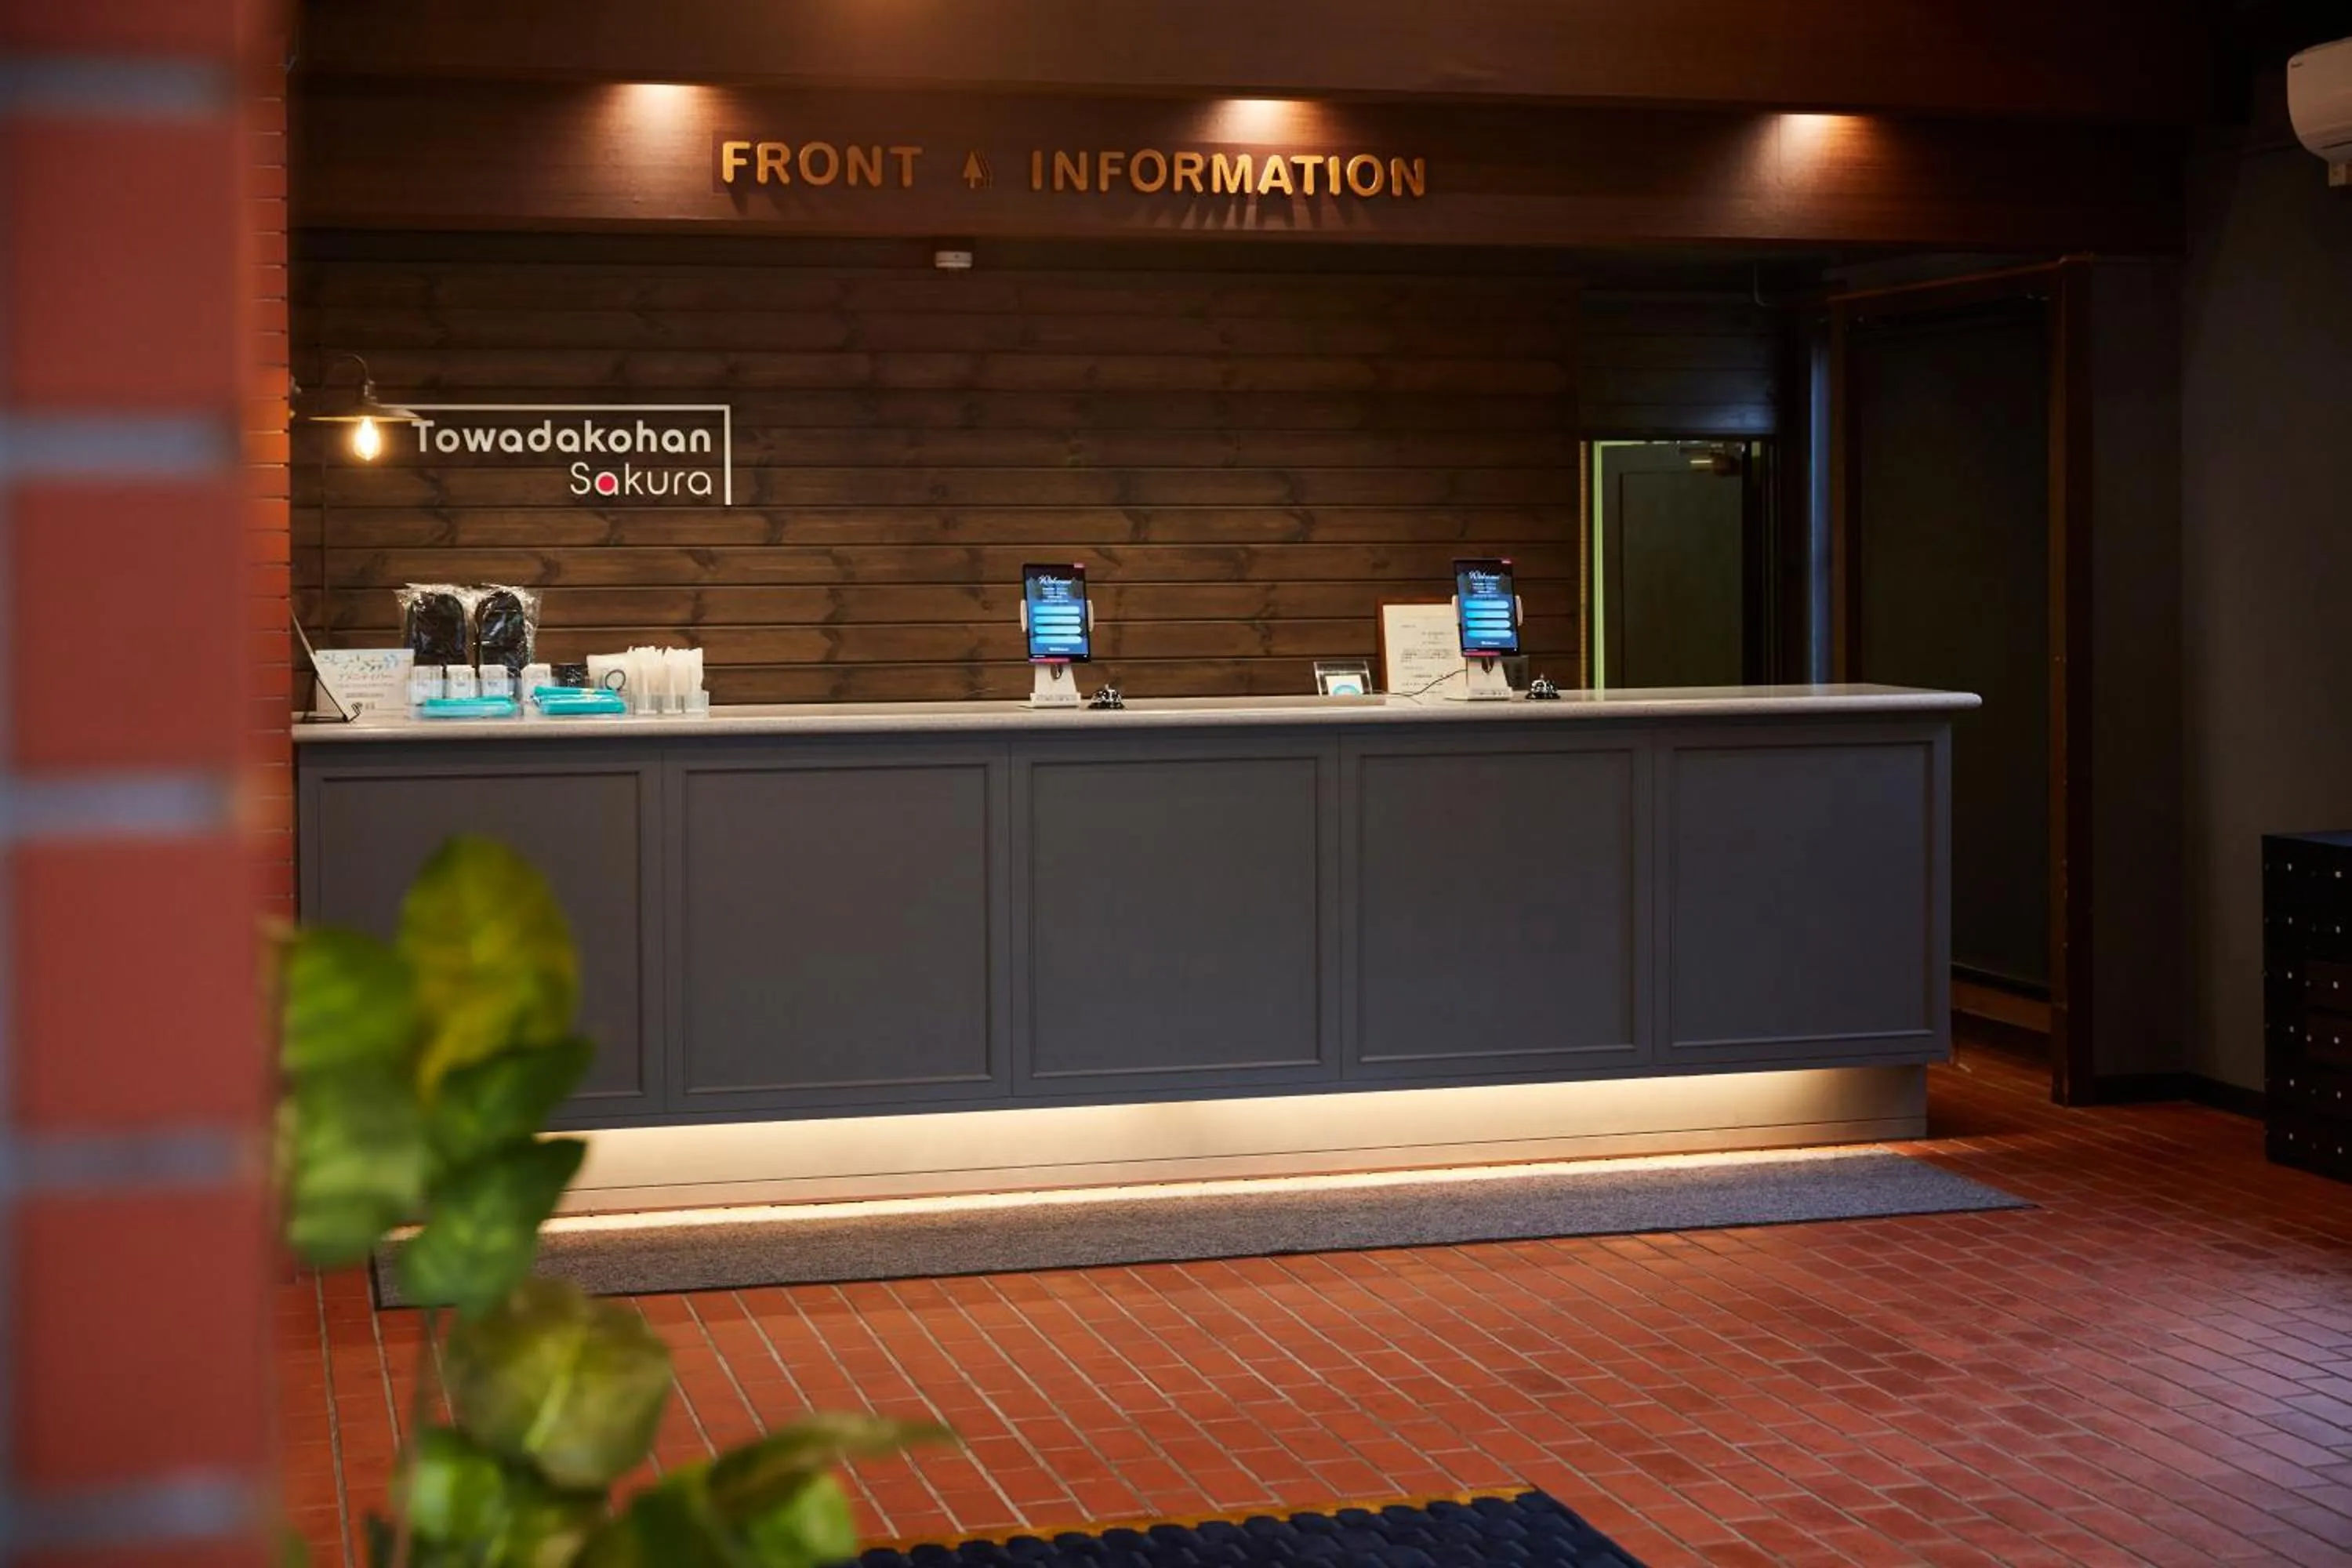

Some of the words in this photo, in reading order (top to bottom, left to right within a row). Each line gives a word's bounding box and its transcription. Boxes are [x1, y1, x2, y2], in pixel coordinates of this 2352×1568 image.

[721, 142, 922, 187] FRONT
[1032, 149, 1426, 197] INFORMATION
[412, 419, 711, 452] Towadakohan
[570, 462, 712, 495] Sakura
